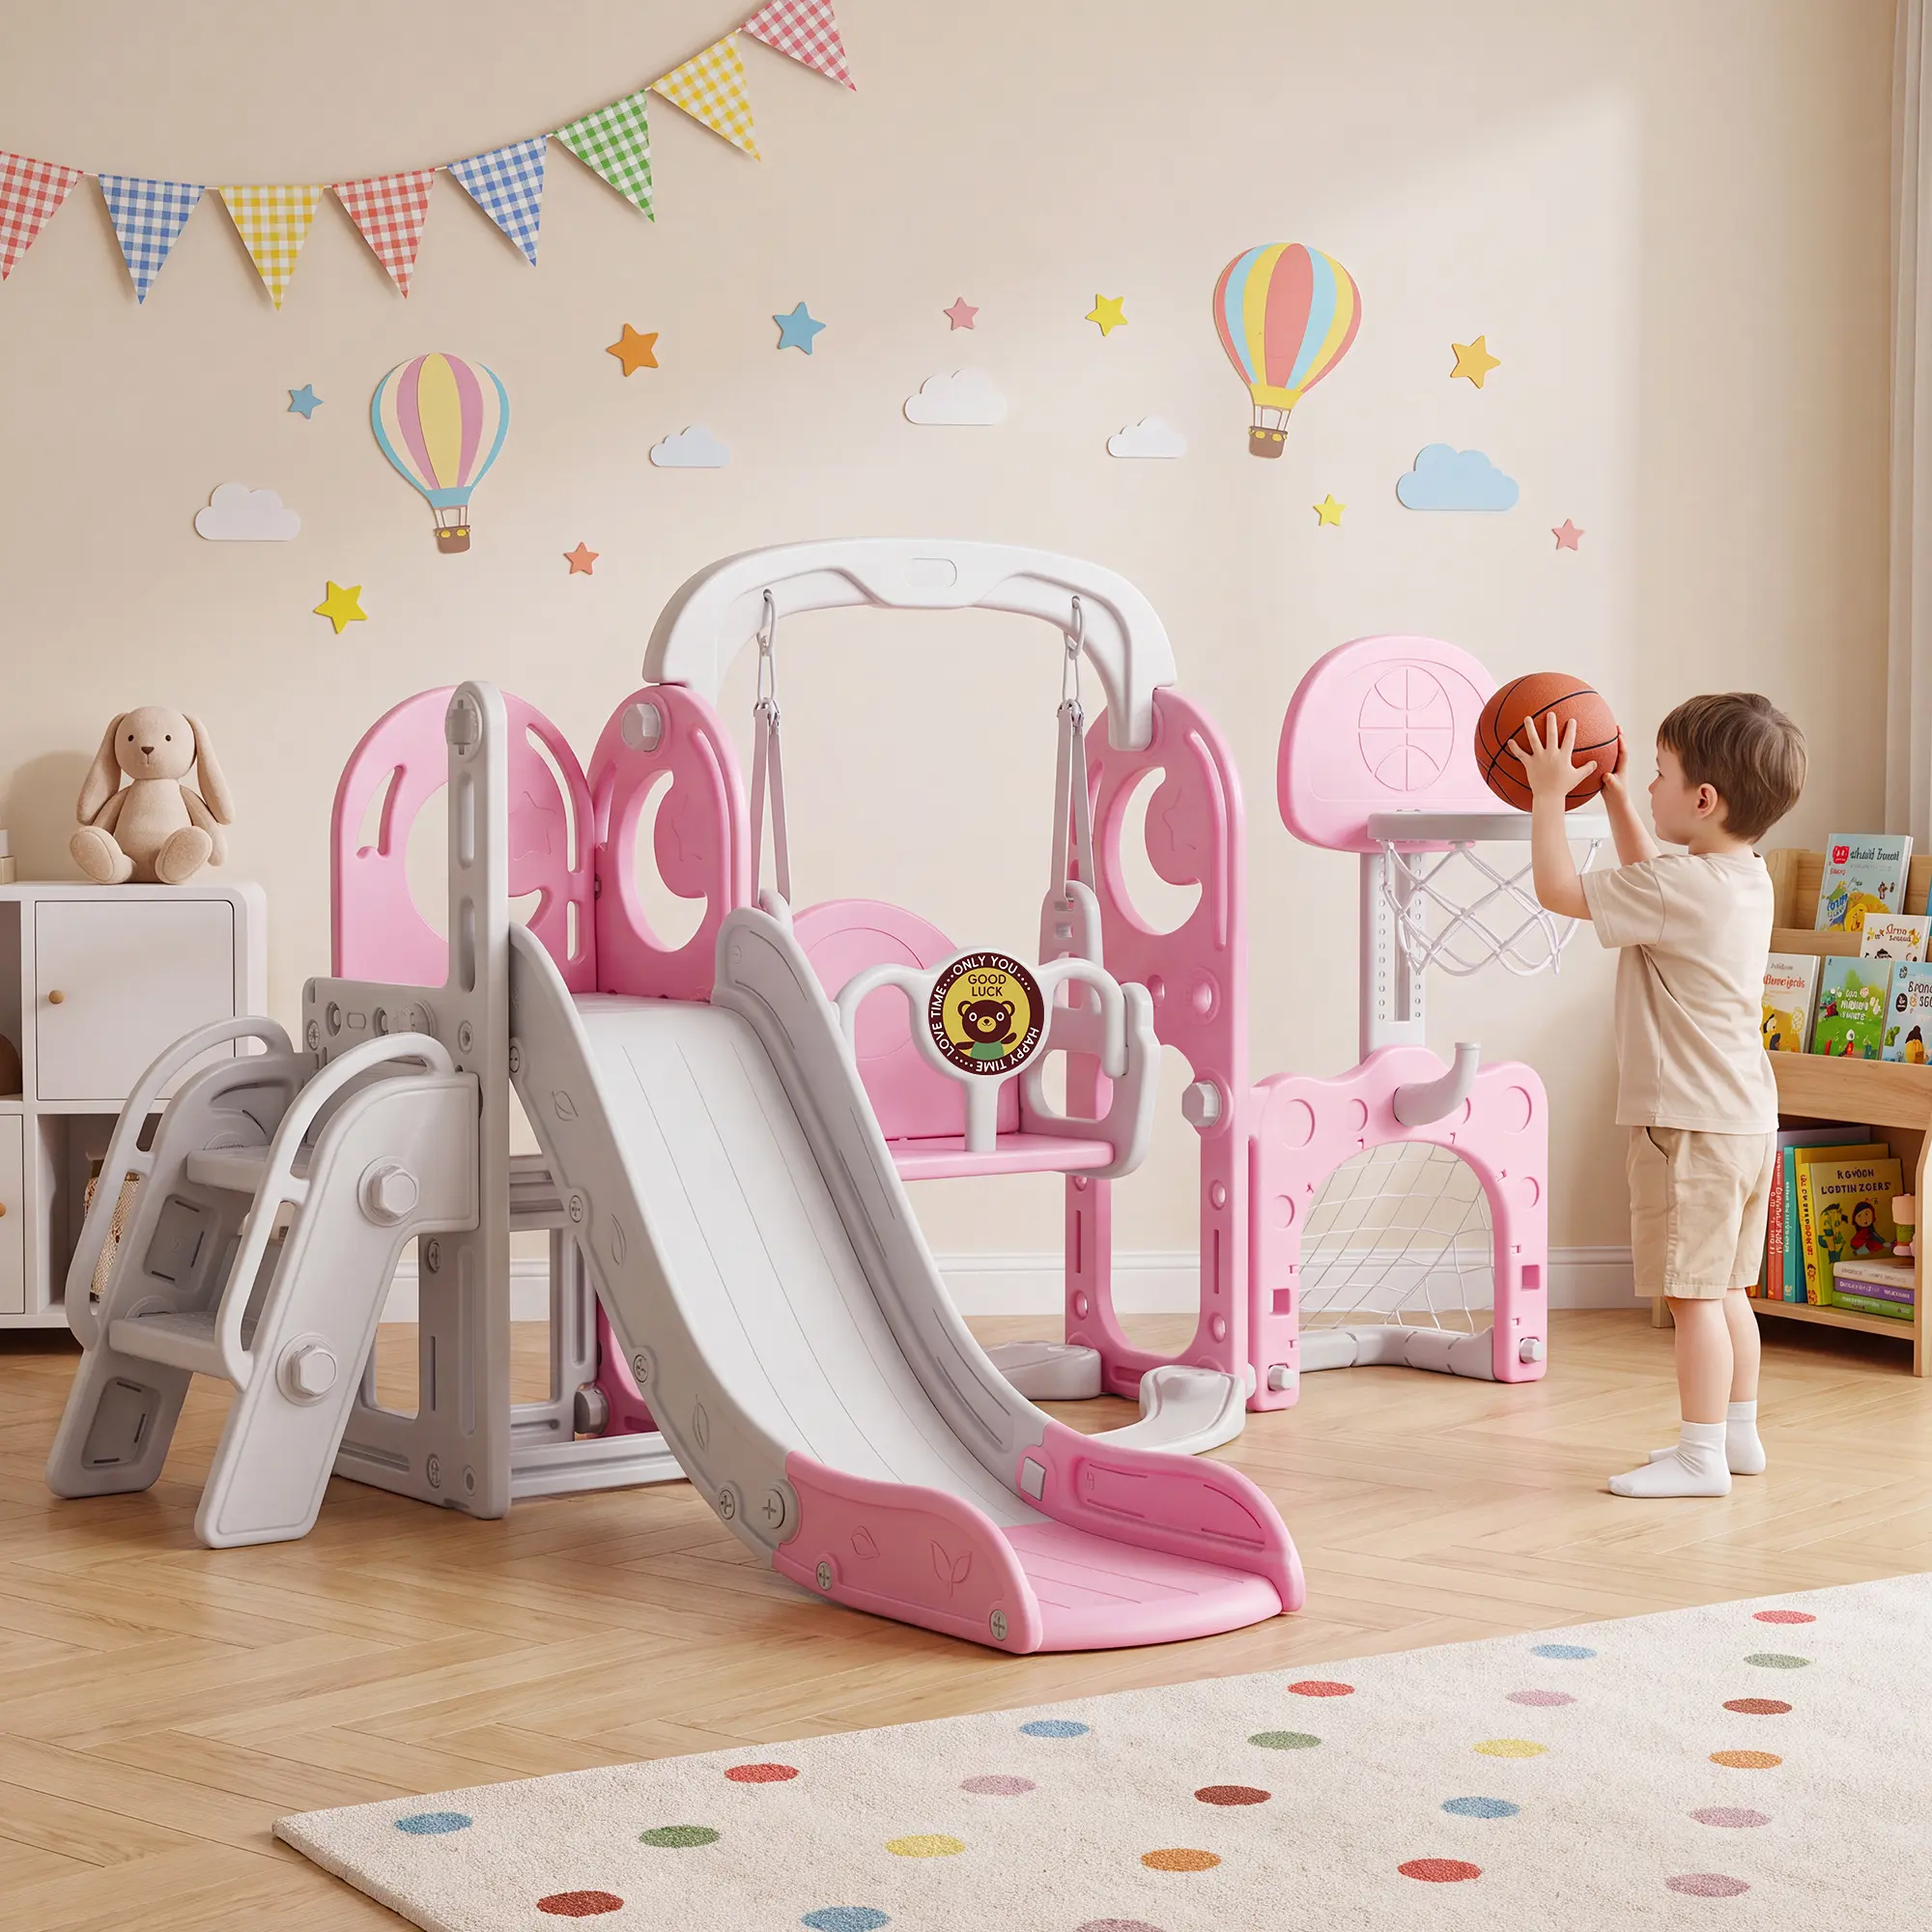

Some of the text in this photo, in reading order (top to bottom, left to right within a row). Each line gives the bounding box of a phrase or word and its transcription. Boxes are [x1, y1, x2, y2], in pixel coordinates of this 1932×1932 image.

[952, 955, 1018, 976] ONLY YOU
[968, 974, 1007, 984] GOOD
[972, 986, 1003, 997] LUCK
[931, 986, 954, 1057] LOVE TIME
[976, 1027, 1039, 1072] HAPPY TIME
